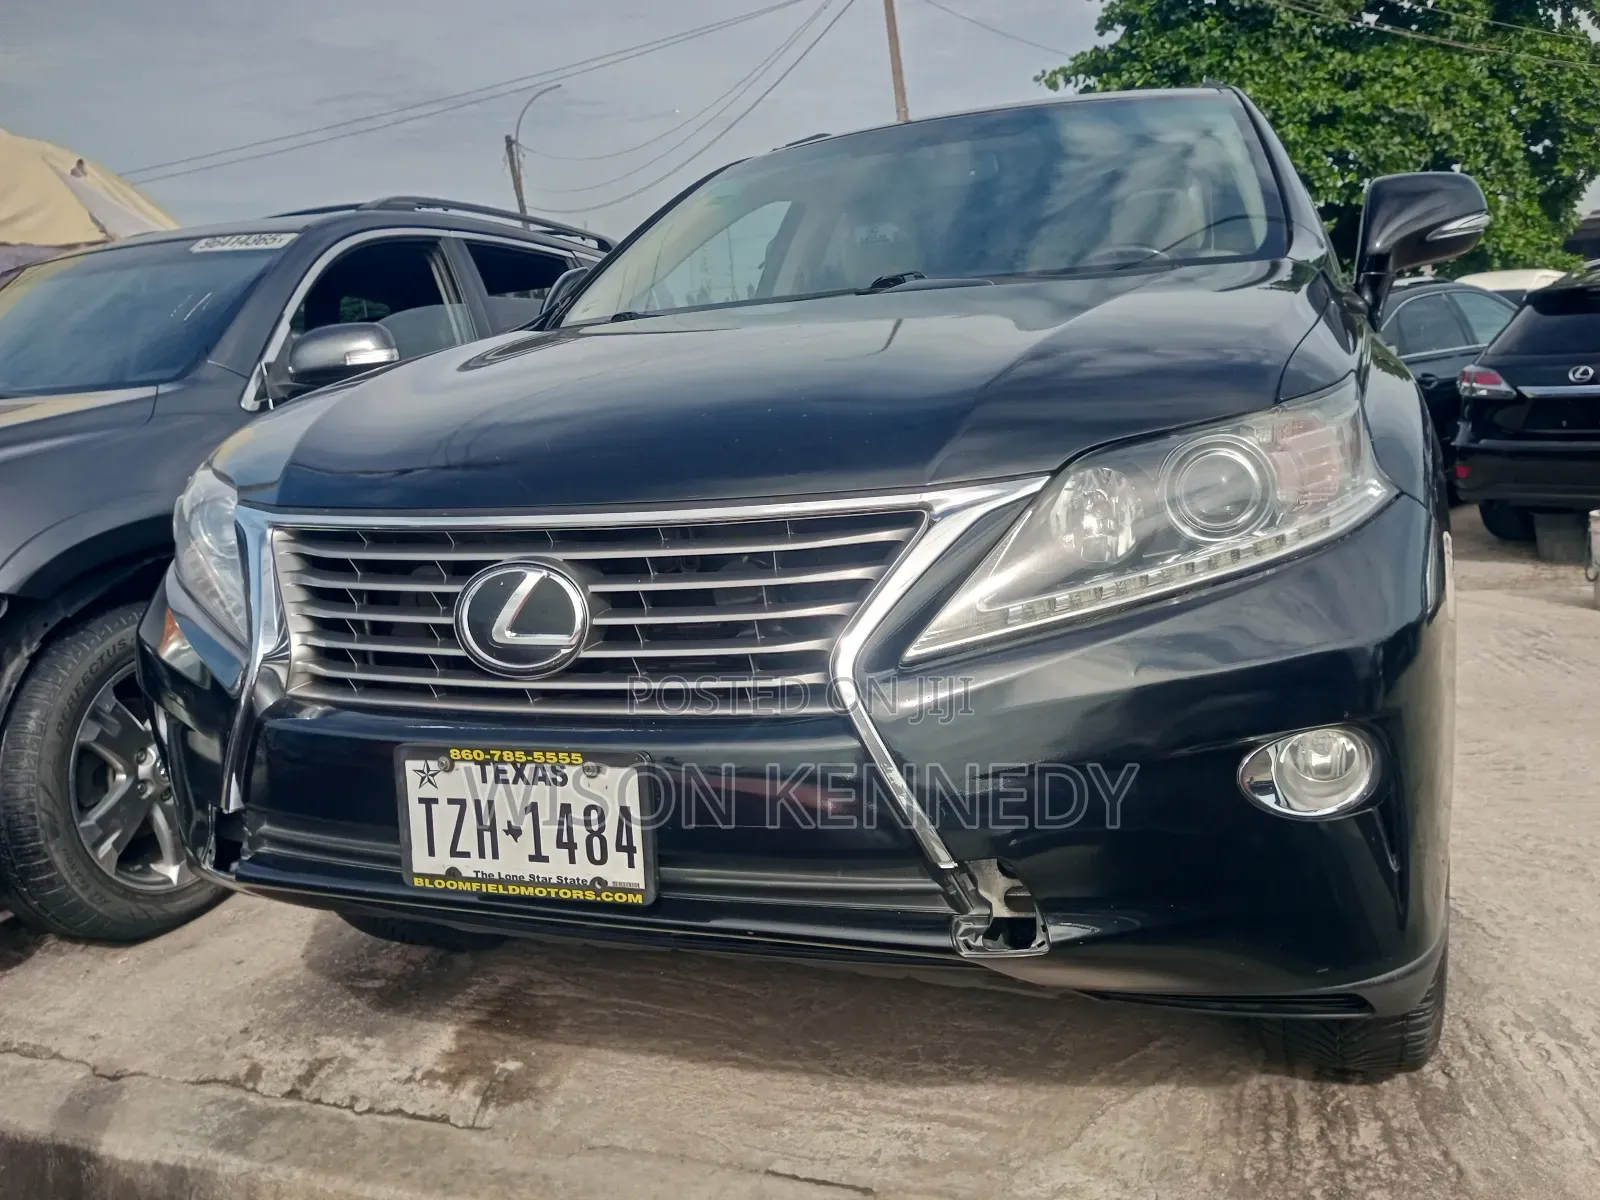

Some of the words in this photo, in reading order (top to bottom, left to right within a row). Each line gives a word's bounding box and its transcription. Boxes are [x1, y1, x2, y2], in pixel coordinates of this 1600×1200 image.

[55, 637, 127, 736] PERFECTUS
[449, 748, 584, 765] 860-785-5555
[474, 760, 569, 788] TEXAS
[412, 876, 644, 905] BLOOMFIELDMOTORS.COM
[472, 870, 495, 879] The
[497, 871, 525, 882] Lone
[528, 873, 553, 884] Star
[556, 875, 589, 887] State
